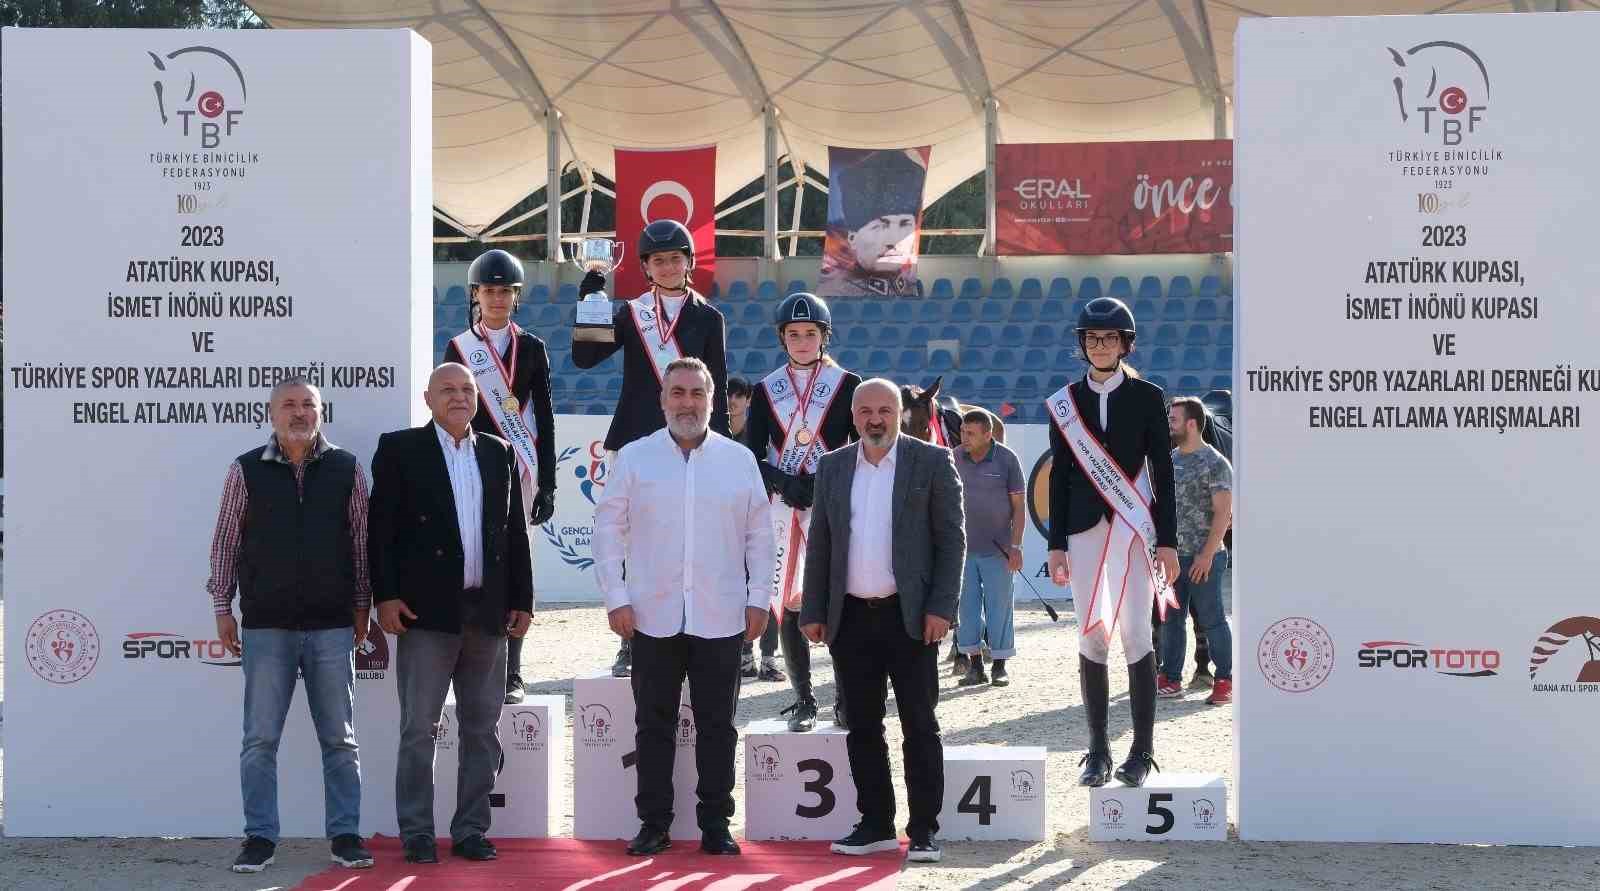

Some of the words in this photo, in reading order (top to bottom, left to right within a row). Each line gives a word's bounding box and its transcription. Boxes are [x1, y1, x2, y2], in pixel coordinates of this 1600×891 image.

[177, 110, 243, 148] TBF
[1417, 106, 1486, 145] TBF
[150, 152, 198, 163] TÜRKİYE
[1388, 149, 1440, 161] TÜRKİYE
[163, 167, 245, 177] FEDERASYONU
[1403, 166, 1489, 176] FEDERASYONU
[193, 181, 211, 190] 1923
[1013, 178, 1093, 199] ERAL
[1434, 180, 1453, 189] 1923
[1020, 200, 1089, 210] OKULLARI
[1133, 174, 1222, 218] önce
[180, 225, 225, 247] 2023
[1421, 225, 1467, 247] 2023
[126, 256, 206, 283] ATATÜRK
[210, 260, 280, 286] KUPASI,
[1365, 257, 1448, 283] ATATÜRK
[1452, 261, 1525, 287] KUPASI,
[108, 292, 163, 318] İSMET
[168, 292, 224, 318] İNÖNÜ
[229, 296, 293, 318] KUPASI
[1346, 294, 1403, 320] İSMET
[1408, 293, 1466, 320] İNÖNÜ
[1471, 297, 1538, 320] KUPASI
[191, 332, 216, 353] VE
[1432, 334, 1457, 356] VE
[11, 363, 87, 388] TÜRKİYE
[92, 367, 139, 389] SPOR
[144, 367, 243, 388] YAZARLARI
[331, 366, 395, 388] KUPASI
[1246, 365, 1324, 392] TÜRKİYE
[1329, 370, 1378, 392] SPOR
[1382, 370, 1485, 392] YAZARLARI
[1491, 364, 1572, 392] DERNEĞİ
[73, 403, 130, 424] ENGEL
[134, 403, 208, 424] ATLAMA
[1310, 406, 1368, 428] ENGEL
[1372, 406, 1448, 428] ATLAMA
[1453, 406, 1580, 434] YARIŞMALARI
[1532, 684, 1559, 694] ADANA
[1560, 684, 1576, 693] ATLI
[1578, 684, 1599, 693] SPOR
[796, 758, 837, 819] 3
[957, 775, 997, 826] 4
[1145, 792, 1175, 835] 5
